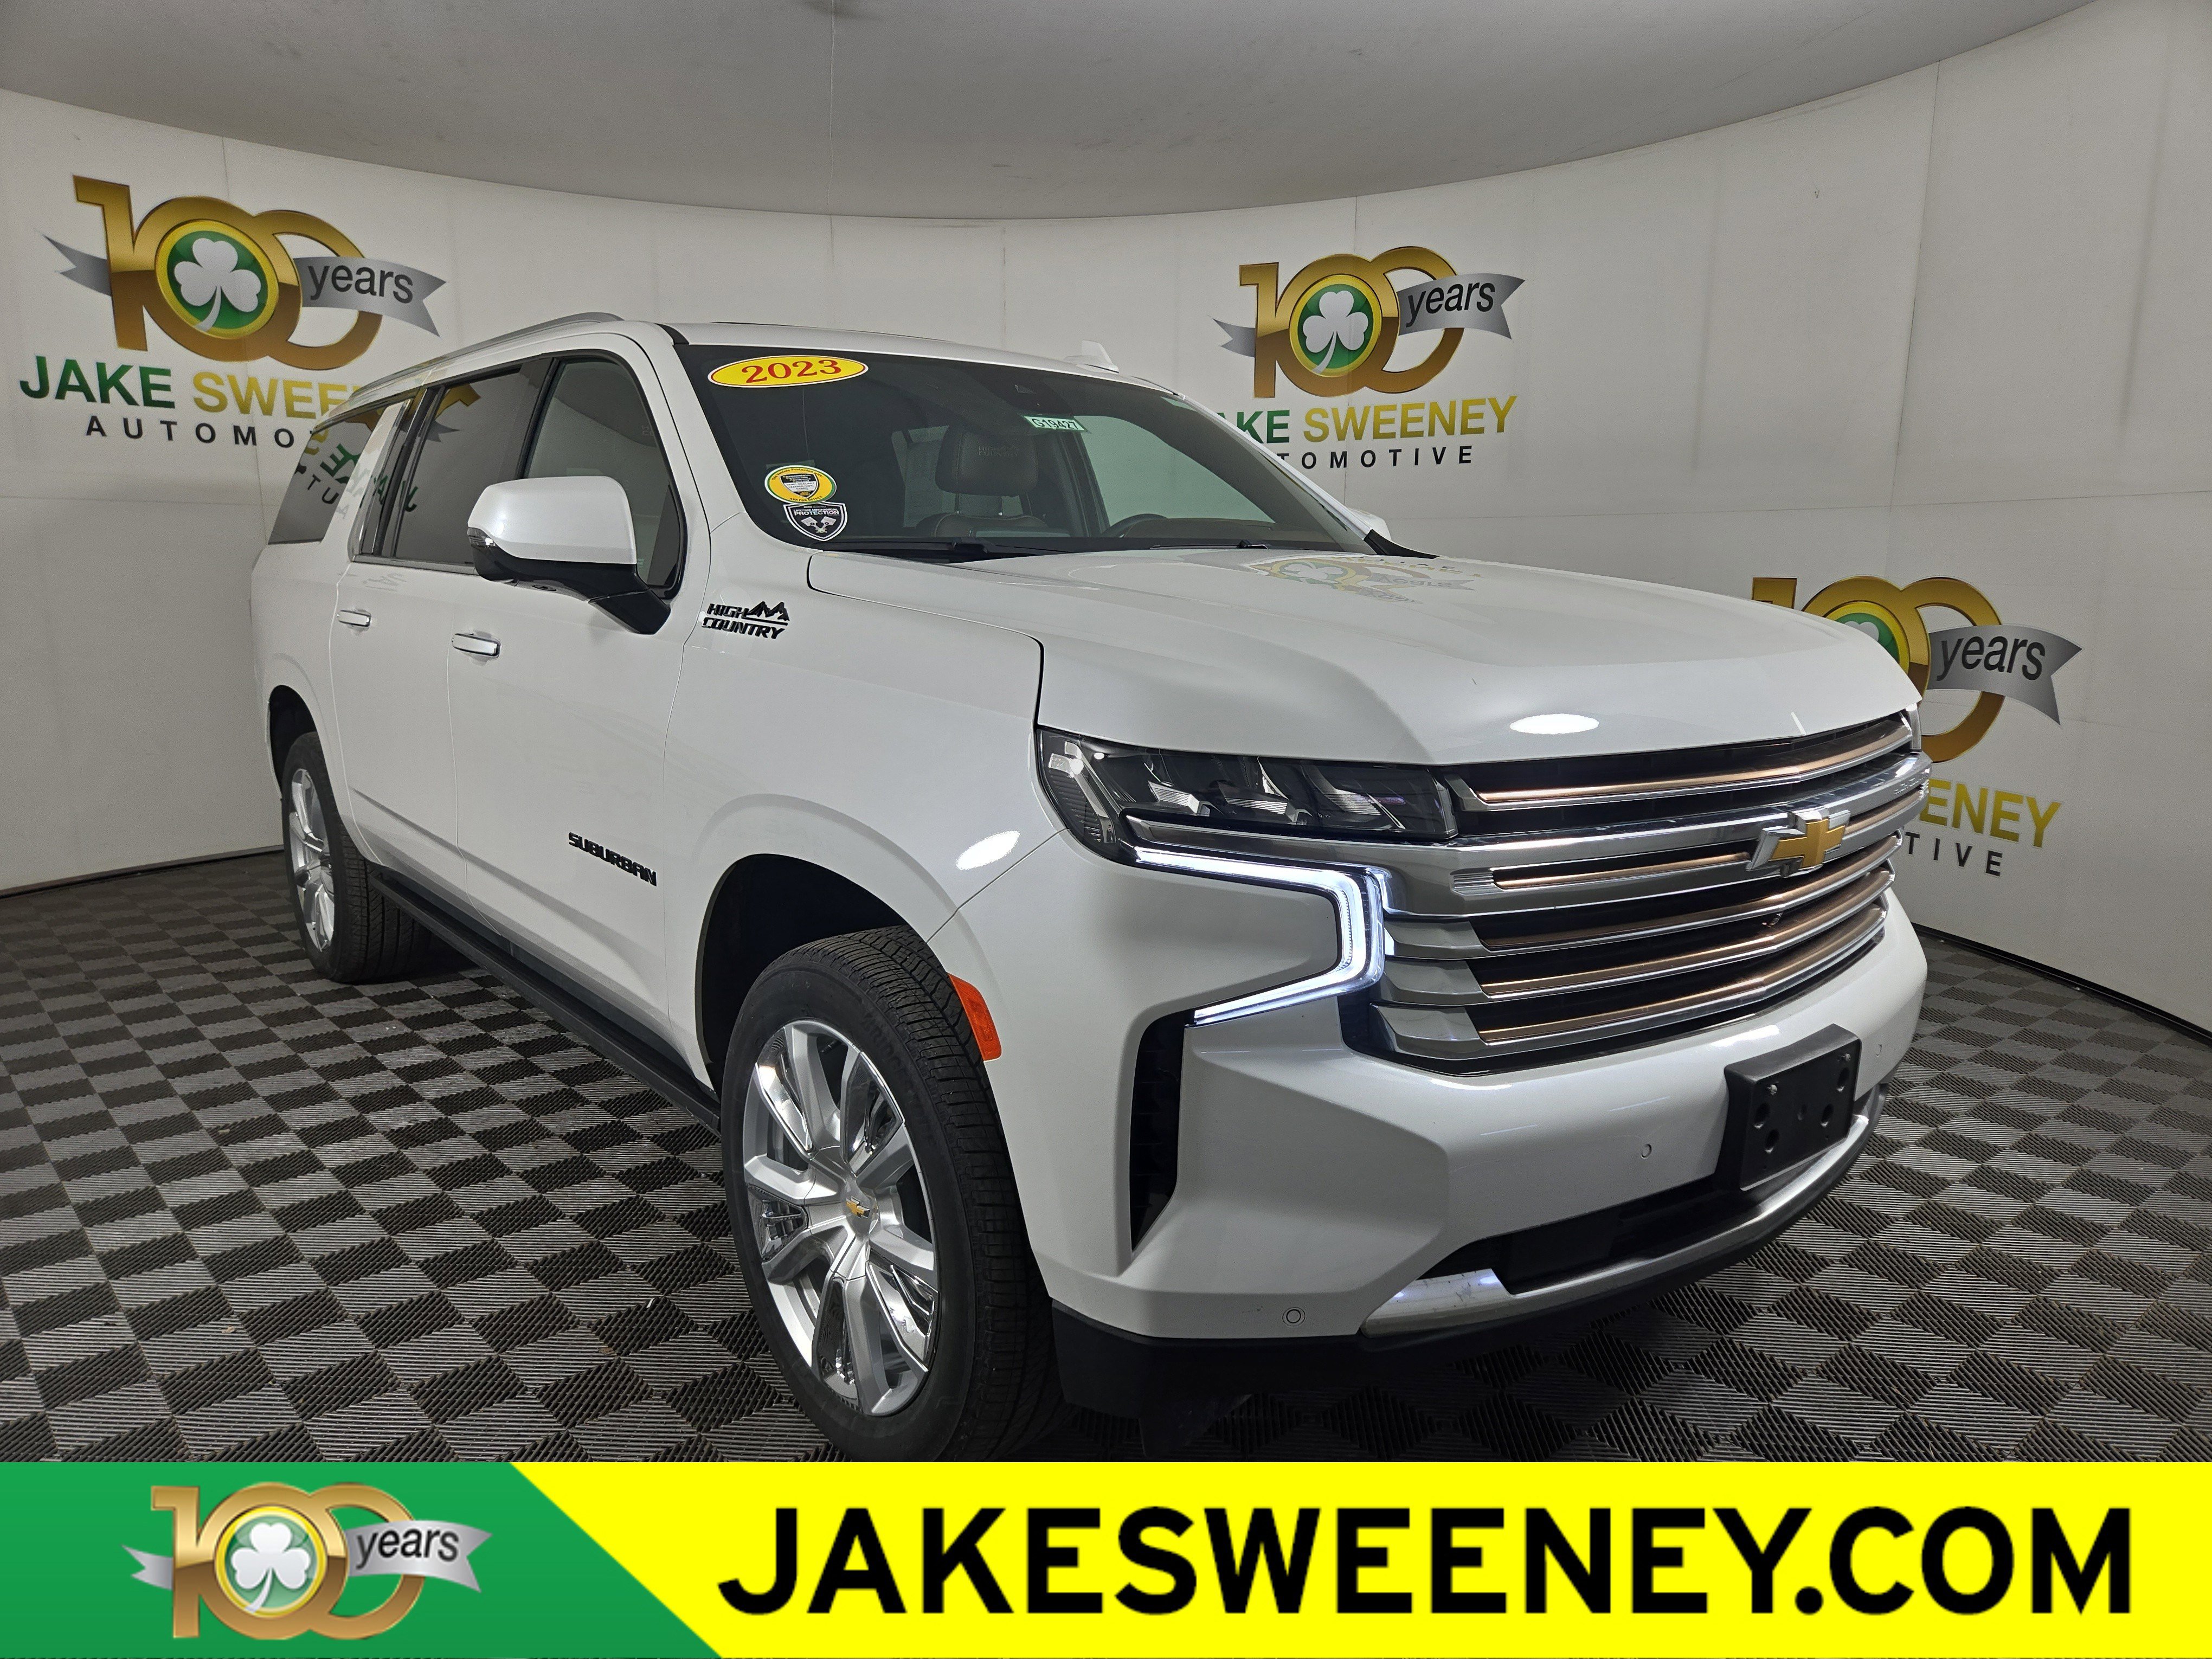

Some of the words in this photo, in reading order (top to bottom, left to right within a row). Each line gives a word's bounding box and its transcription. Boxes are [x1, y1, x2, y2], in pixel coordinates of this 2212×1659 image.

[307, 263, 414, 304] years
[1406, 280, 1496, 328] years
[20, 356, 176, 409] JAKE
[192, 371, 361, 420] SWEE
[741, 359, 841, 383] 2023
[86, 415, 295, 448] AUTOMO
[1031, 418, 1079, 430] G19427
[1217, 409, 1290, 444] KE
[1303, 395, 1517, 443] SWEENEY
[702, 616, 786, 640] COUNTRY
[706, 603, 750, 619] HIGH
[1936, 635, 2046, 681] years
[1919, 778, 2062, 848] ENEY
[568, 832, 657, 887] SUBURBAN
